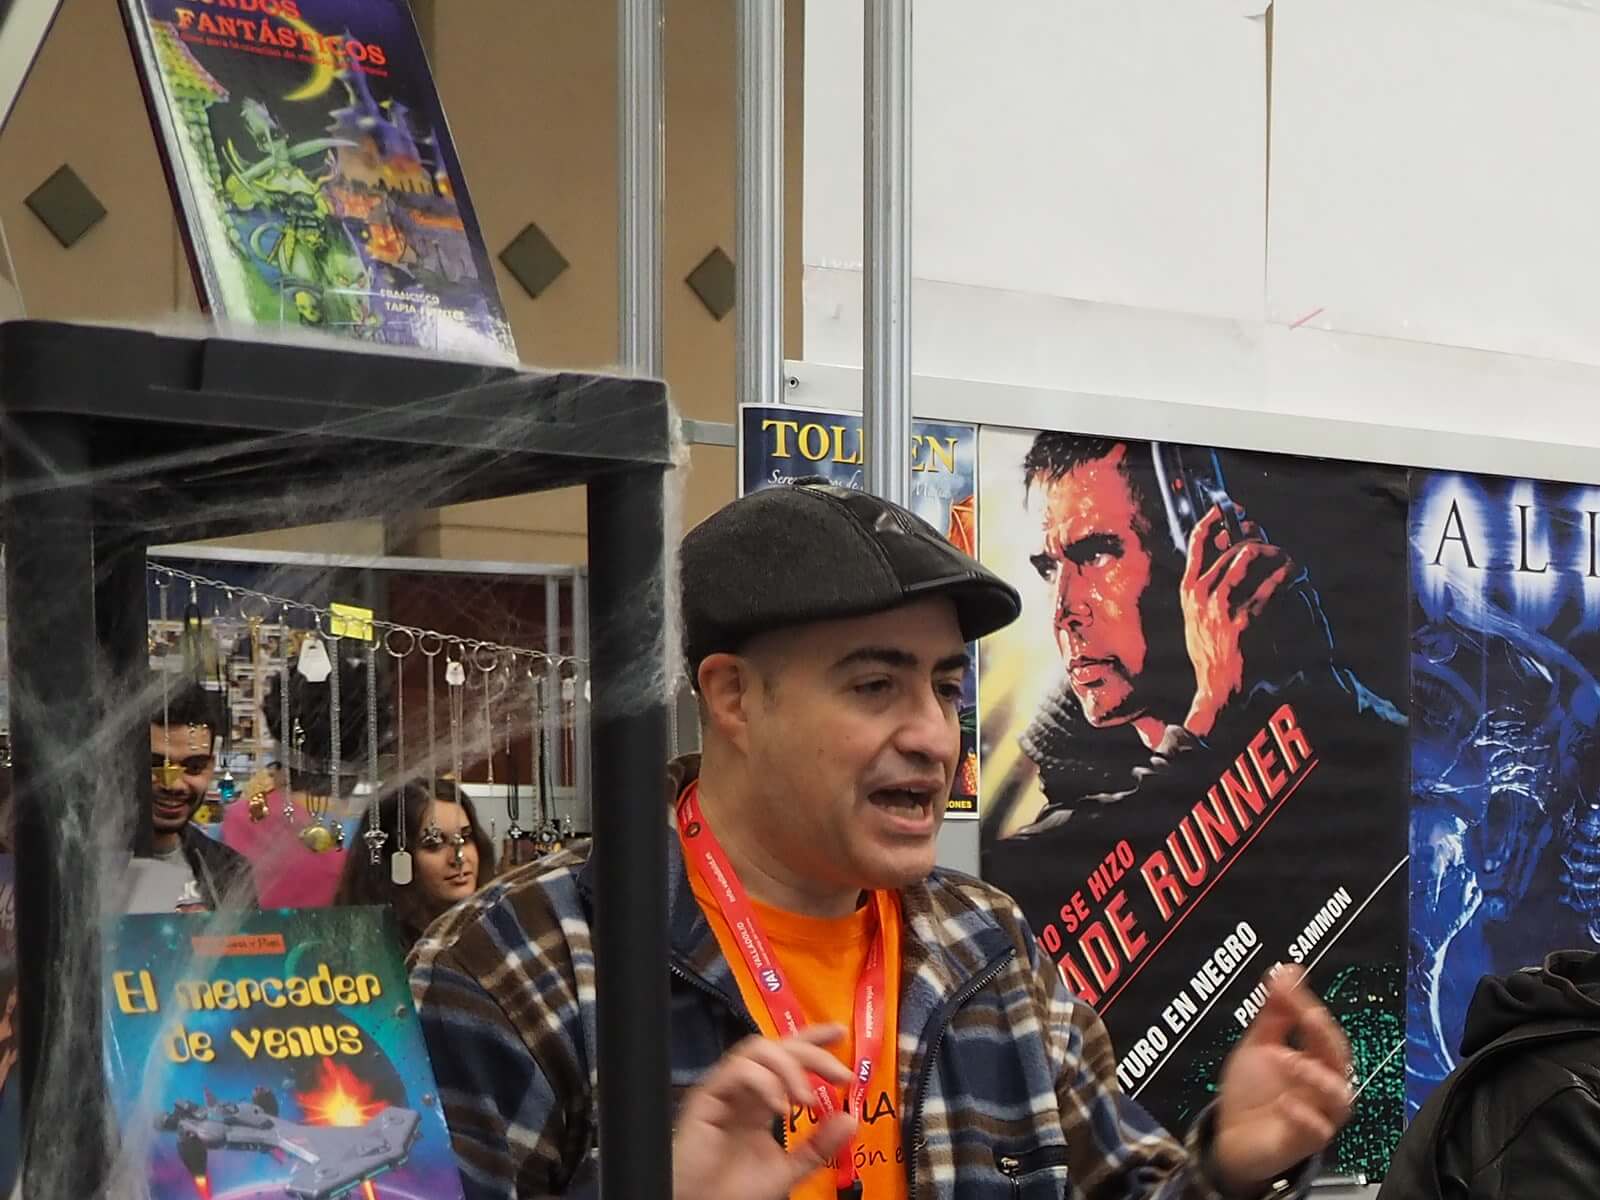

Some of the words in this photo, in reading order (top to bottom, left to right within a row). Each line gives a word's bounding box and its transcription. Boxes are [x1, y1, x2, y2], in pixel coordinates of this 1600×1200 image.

[176, 7, 388, 65] FANTÁSTICOS
[1140, 703, 1313, 922] RUNNER
[1060, 891, 1092, 934] SE
[1087, 839, 1135, 903] HIZO
[1288, 886, 1353, 963] SAMMON
[112, 969, 159, 1014] El
[176, 963, 382, 1010] mercader
[1116, 1025, 1169, 1094] TURO
[1162, 991, 1198, 1034] EN
[1190, 921, 1258, 1002] NEGRO
[166, 1023, 216, 1063] de
[230, 1024, 363, 1059] venus
